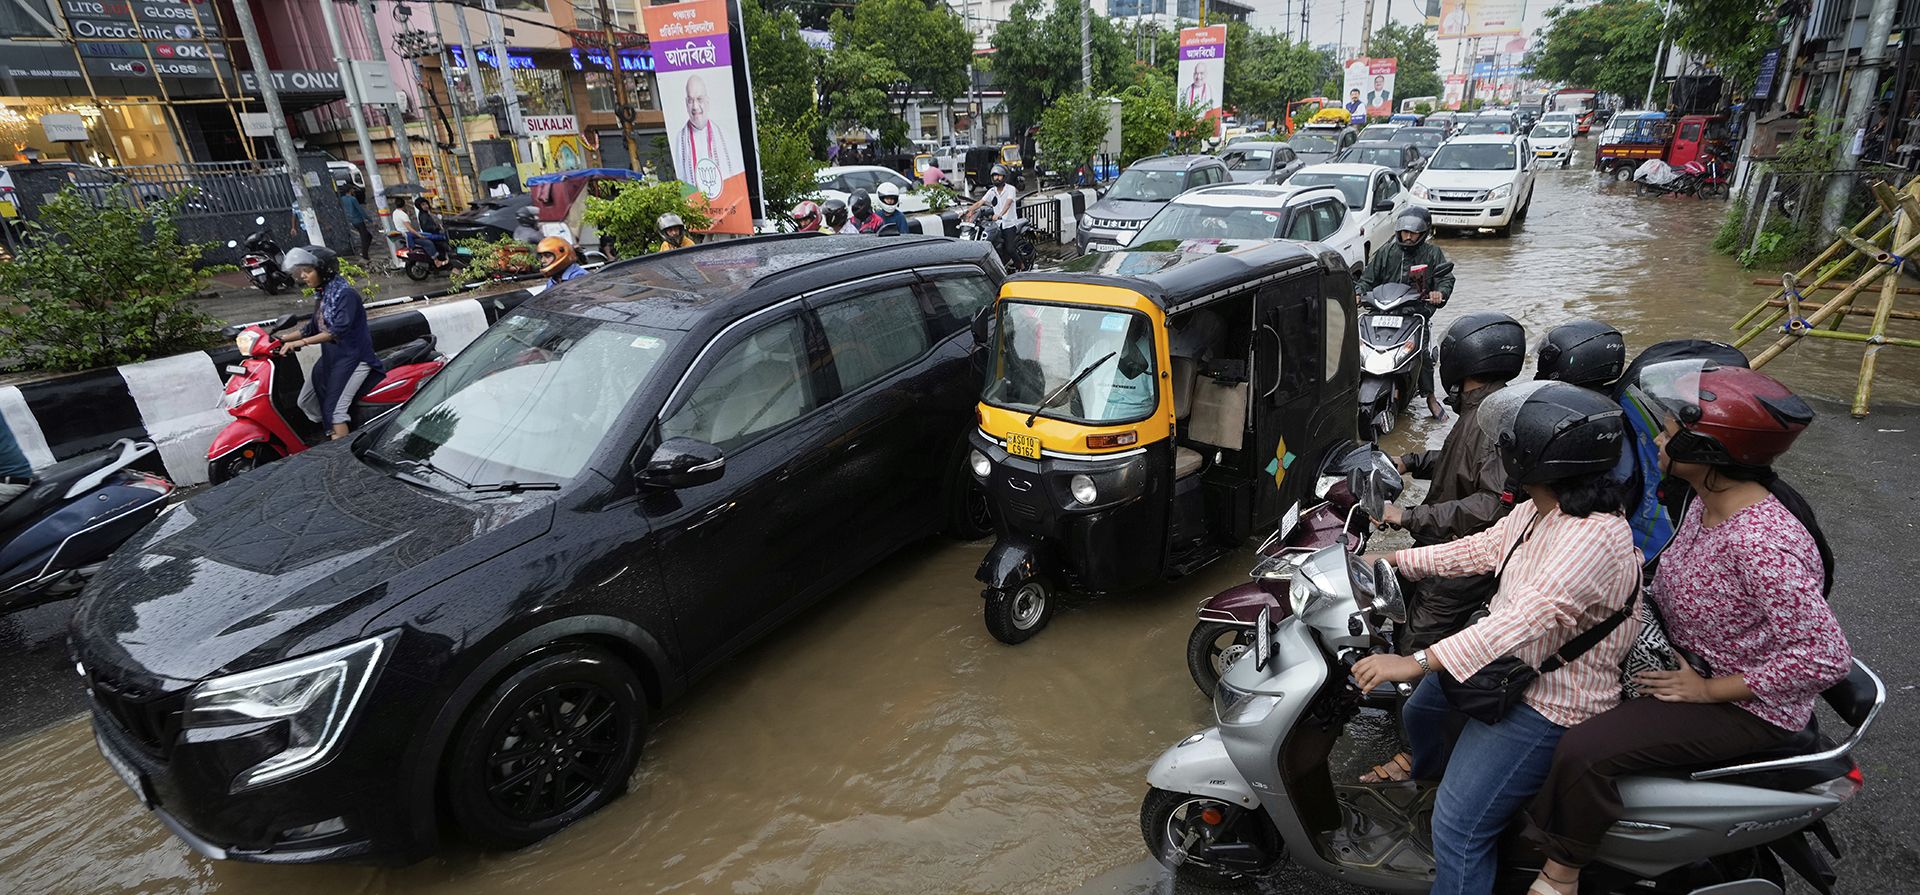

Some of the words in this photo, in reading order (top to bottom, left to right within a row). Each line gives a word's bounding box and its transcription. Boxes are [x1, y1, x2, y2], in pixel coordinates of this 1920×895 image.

[75, 20, 126, 37] Orca
[127, 25, 174, 40] cinic
[175, 45, 204, 58] OK
[242, 73, 286, 90] EIT
[292, 72, 339, 89] ONLY
[527, 117, 573, 131] SILKALAY
